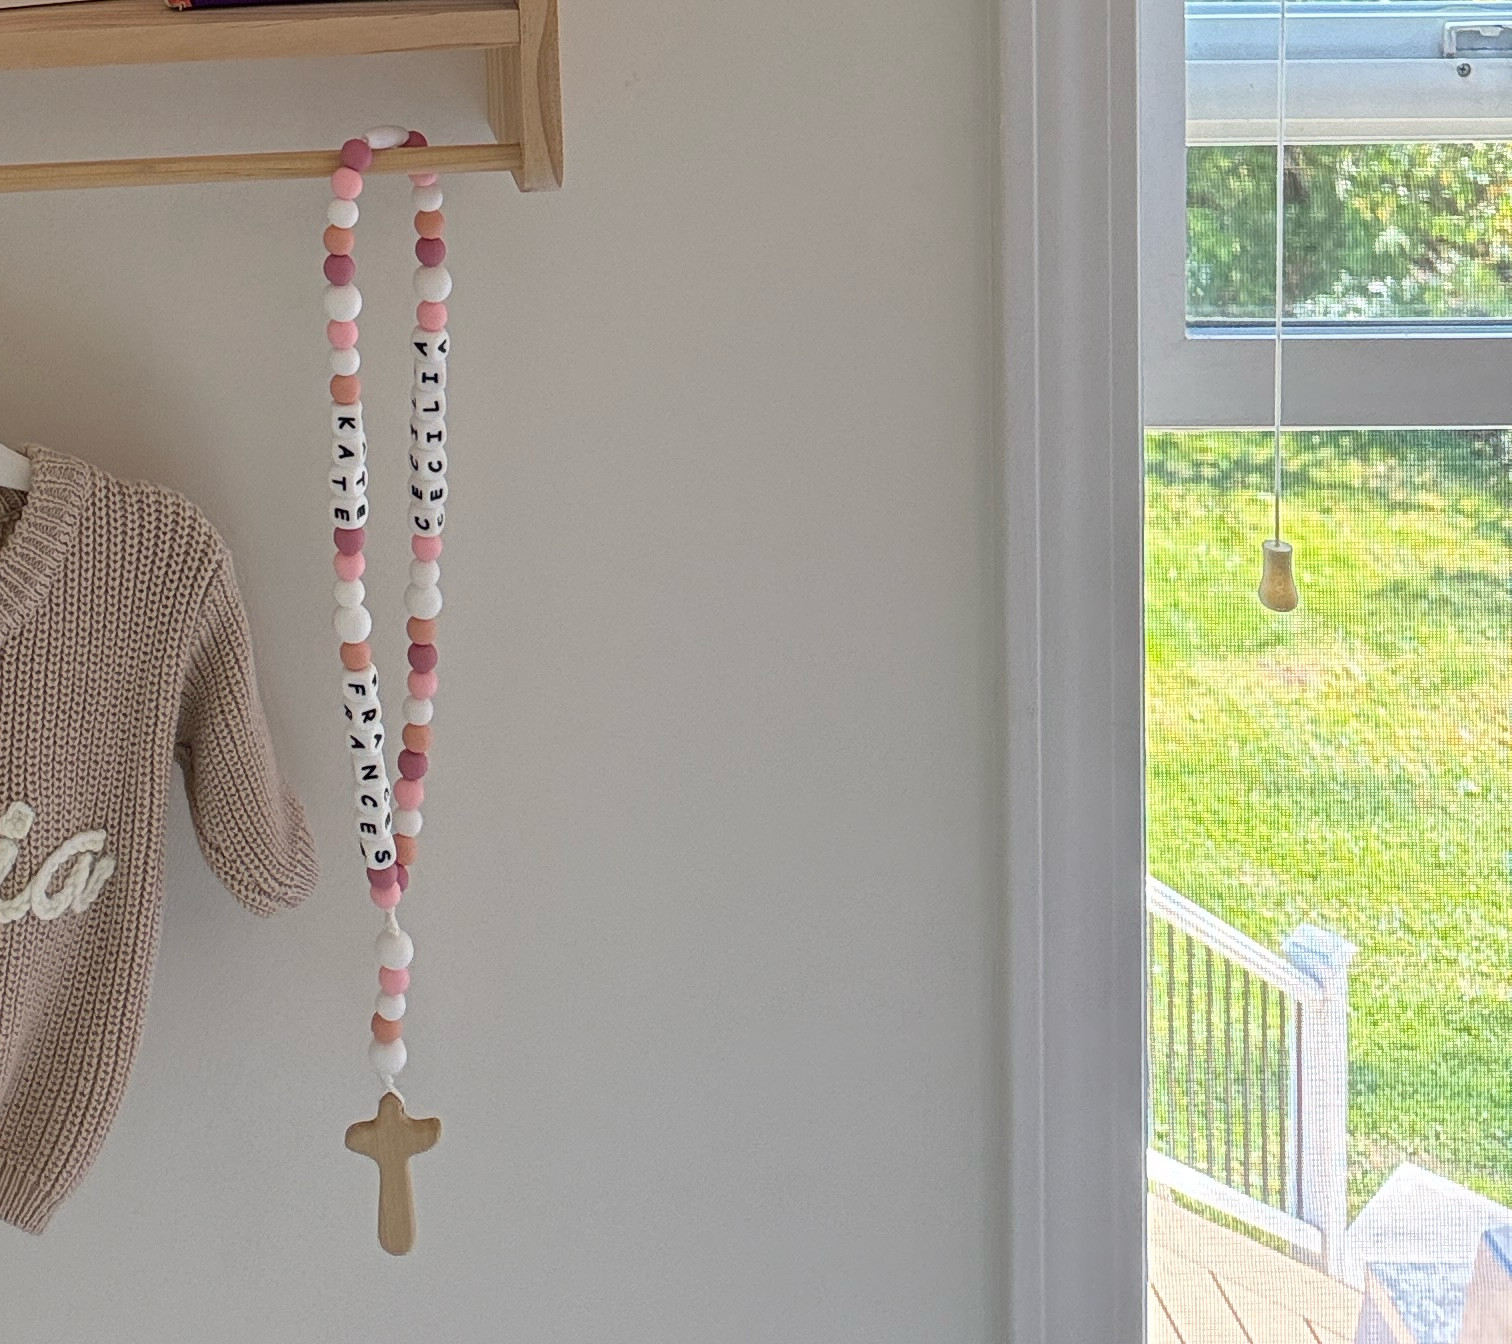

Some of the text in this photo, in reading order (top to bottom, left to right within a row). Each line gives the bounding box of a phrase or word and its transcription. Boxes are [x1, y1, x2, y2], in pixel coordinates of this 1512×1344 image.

[332, 416, 356, 522] KATE
[413, 340, 444, 531] CECILIA
[347, 682, 391, 864] FRANCES
